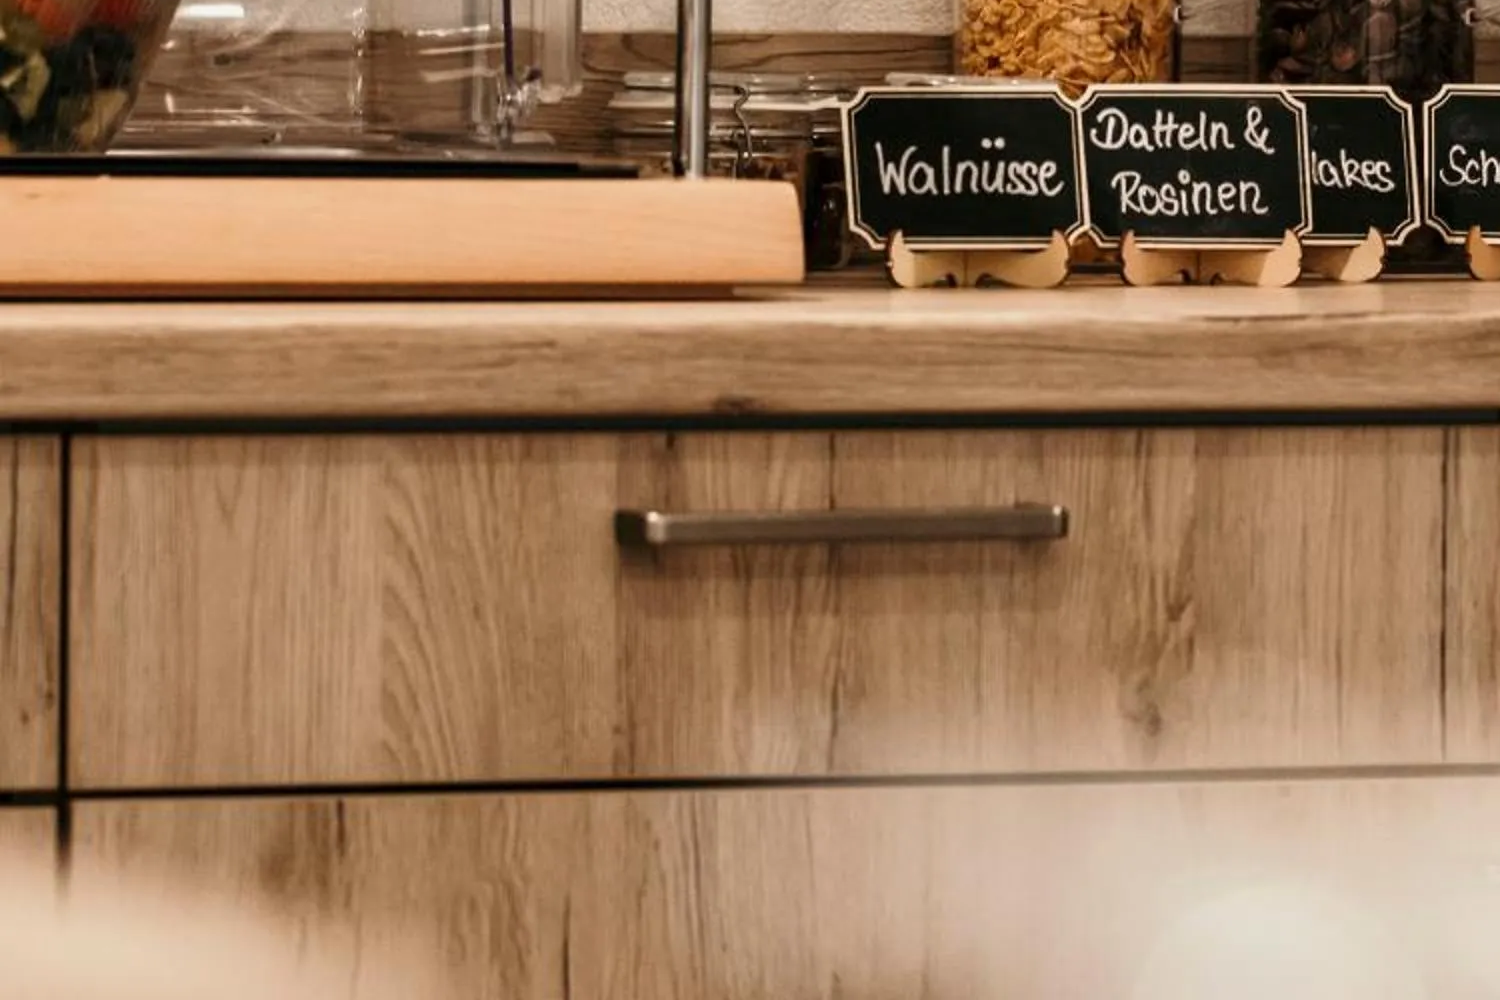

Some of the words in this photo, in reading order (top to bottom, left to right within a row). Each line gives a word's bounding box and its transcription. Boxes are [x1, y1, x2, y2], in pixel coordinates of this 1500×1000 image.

[1090, 105, 1235, 153] Datteln
[1243, 105, 1276, 155] &
[875, 137, 1065, 197] Walnüsse
[1311, 148, 1395, 194] lakes
[1110, 169, 1269, 217] Rosinen
